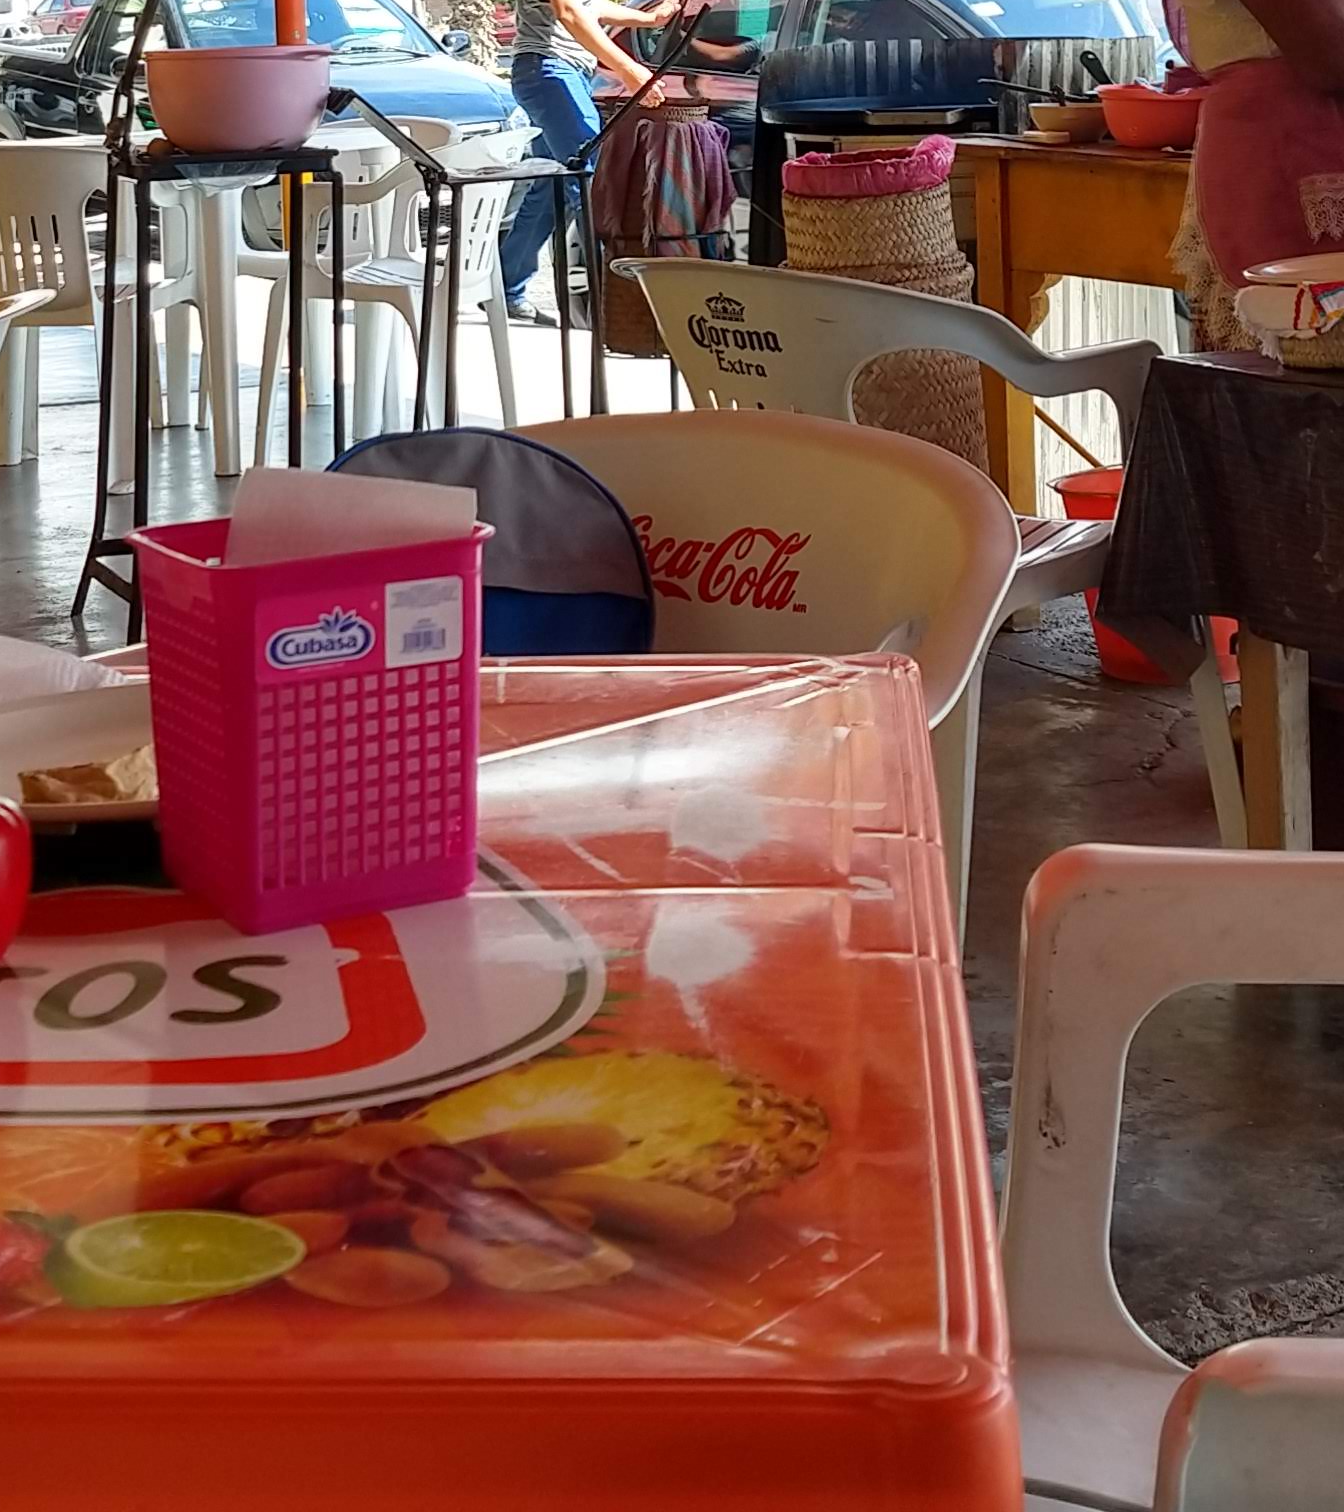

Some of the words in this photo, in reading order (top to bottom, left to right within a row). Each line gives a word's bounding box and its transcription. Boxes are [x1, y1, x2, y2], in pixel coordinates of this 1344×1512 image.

[687, 314, 783, 354] Corona
[710, 348, 768, 379] Extra
[281, 635, 358, 657] Cubasa
